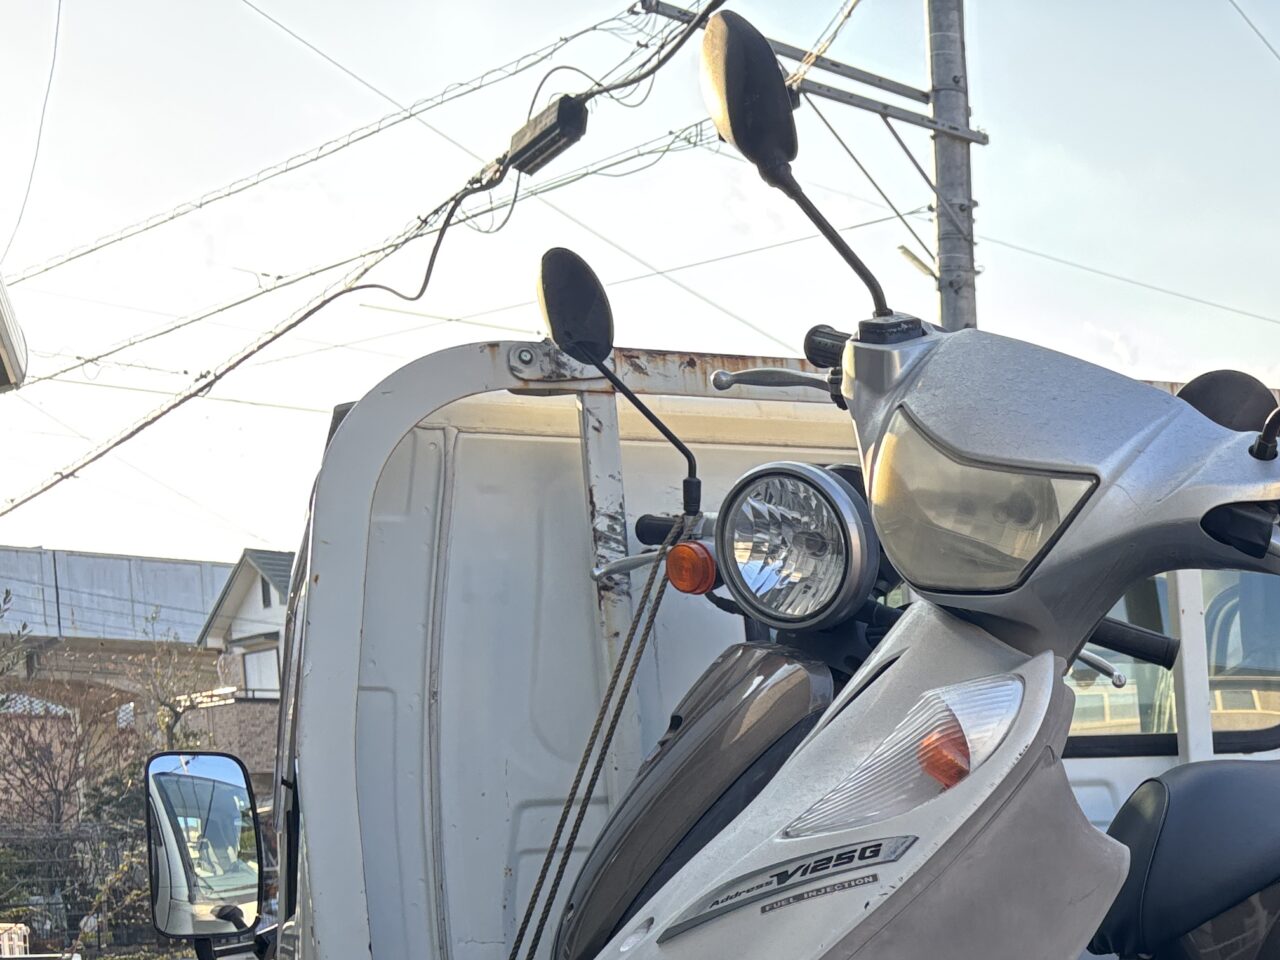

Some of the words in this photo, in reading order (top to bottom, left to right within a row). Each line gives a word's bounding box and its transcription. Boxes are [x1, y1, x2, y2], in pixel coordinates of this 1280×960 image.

[708, 879, 774, 909] Address
[769, 843, 883, 886] V125G
[764, 896, 796, 912] FUEL
[803, 875, 874, 899] INJECTION
